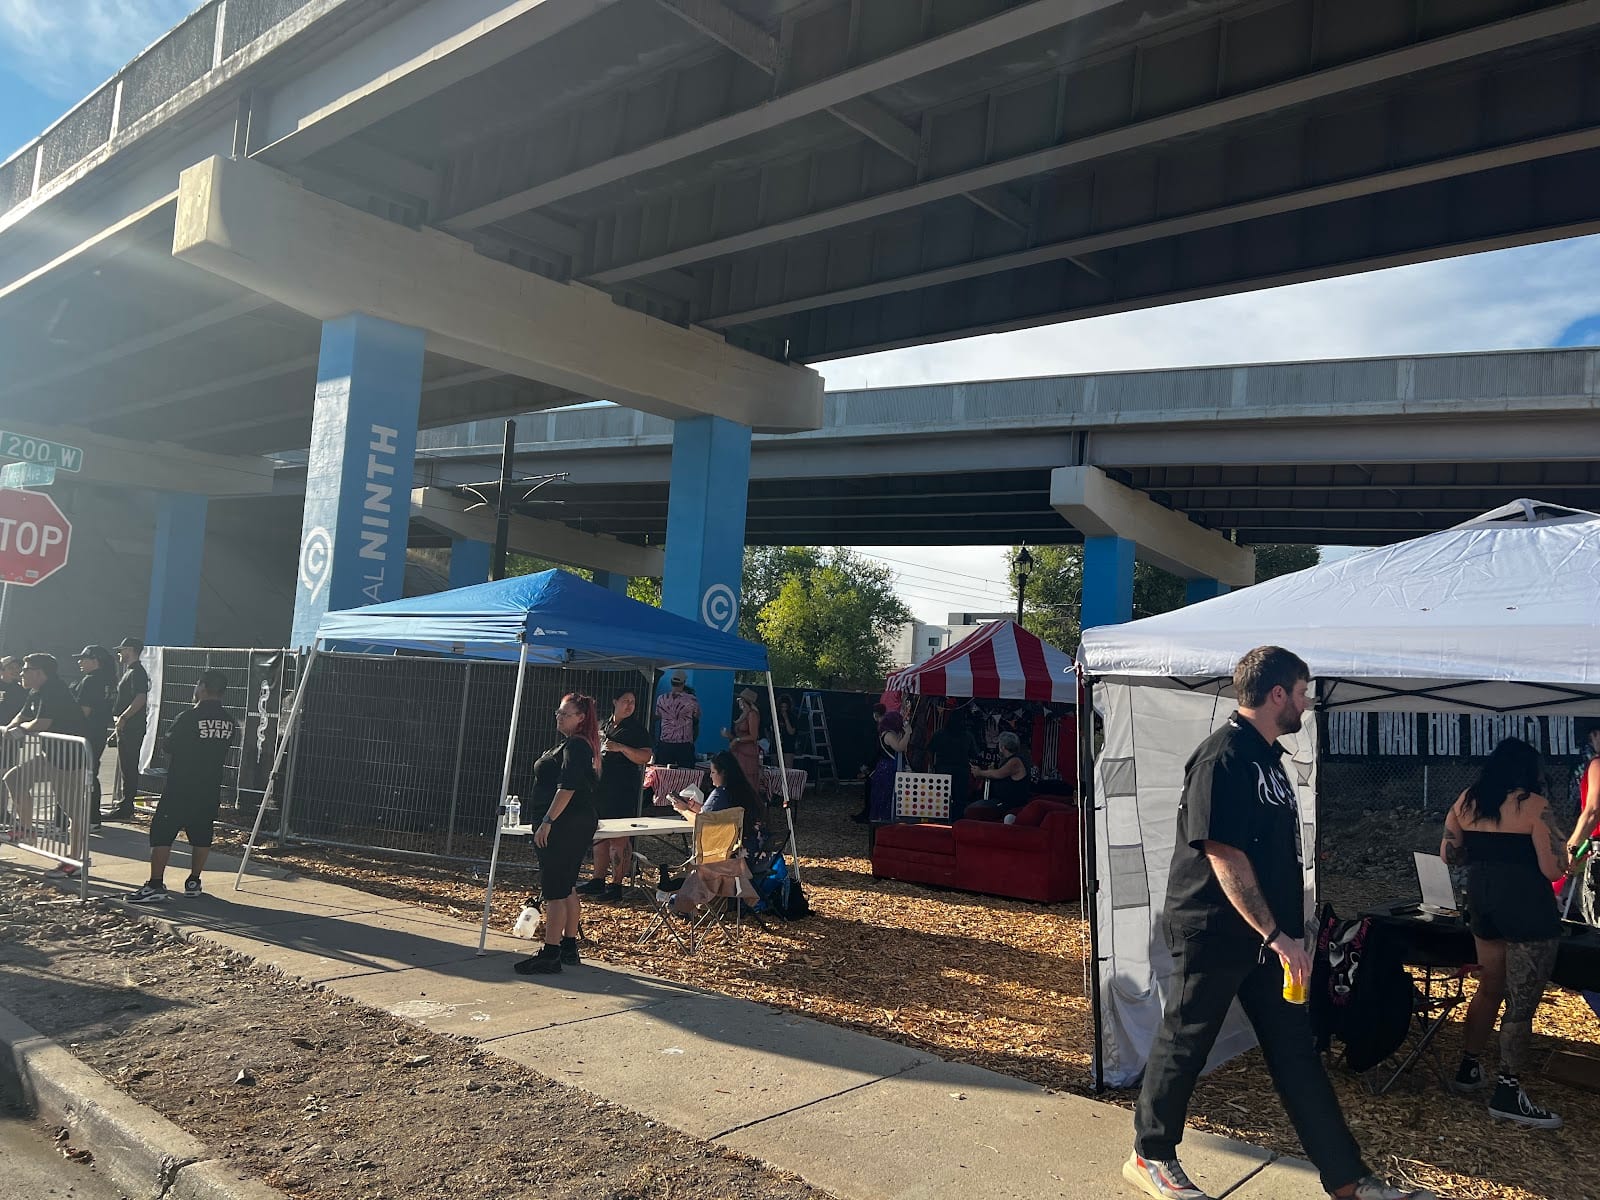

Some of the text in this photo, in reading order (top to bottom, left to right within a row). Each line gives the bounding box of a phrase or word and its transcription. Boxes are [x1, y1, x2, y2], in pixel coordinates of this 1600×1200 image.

[7, 436, 76, 468] 200 W
[359, 424, 399, 605] AL NINTH
[0, 517, 63, 557] TOP
[198, 719, 234, 731] EVENT
[199, 728, 233, 740] STAFF
[1428, 711, 1460, 756] FOR
